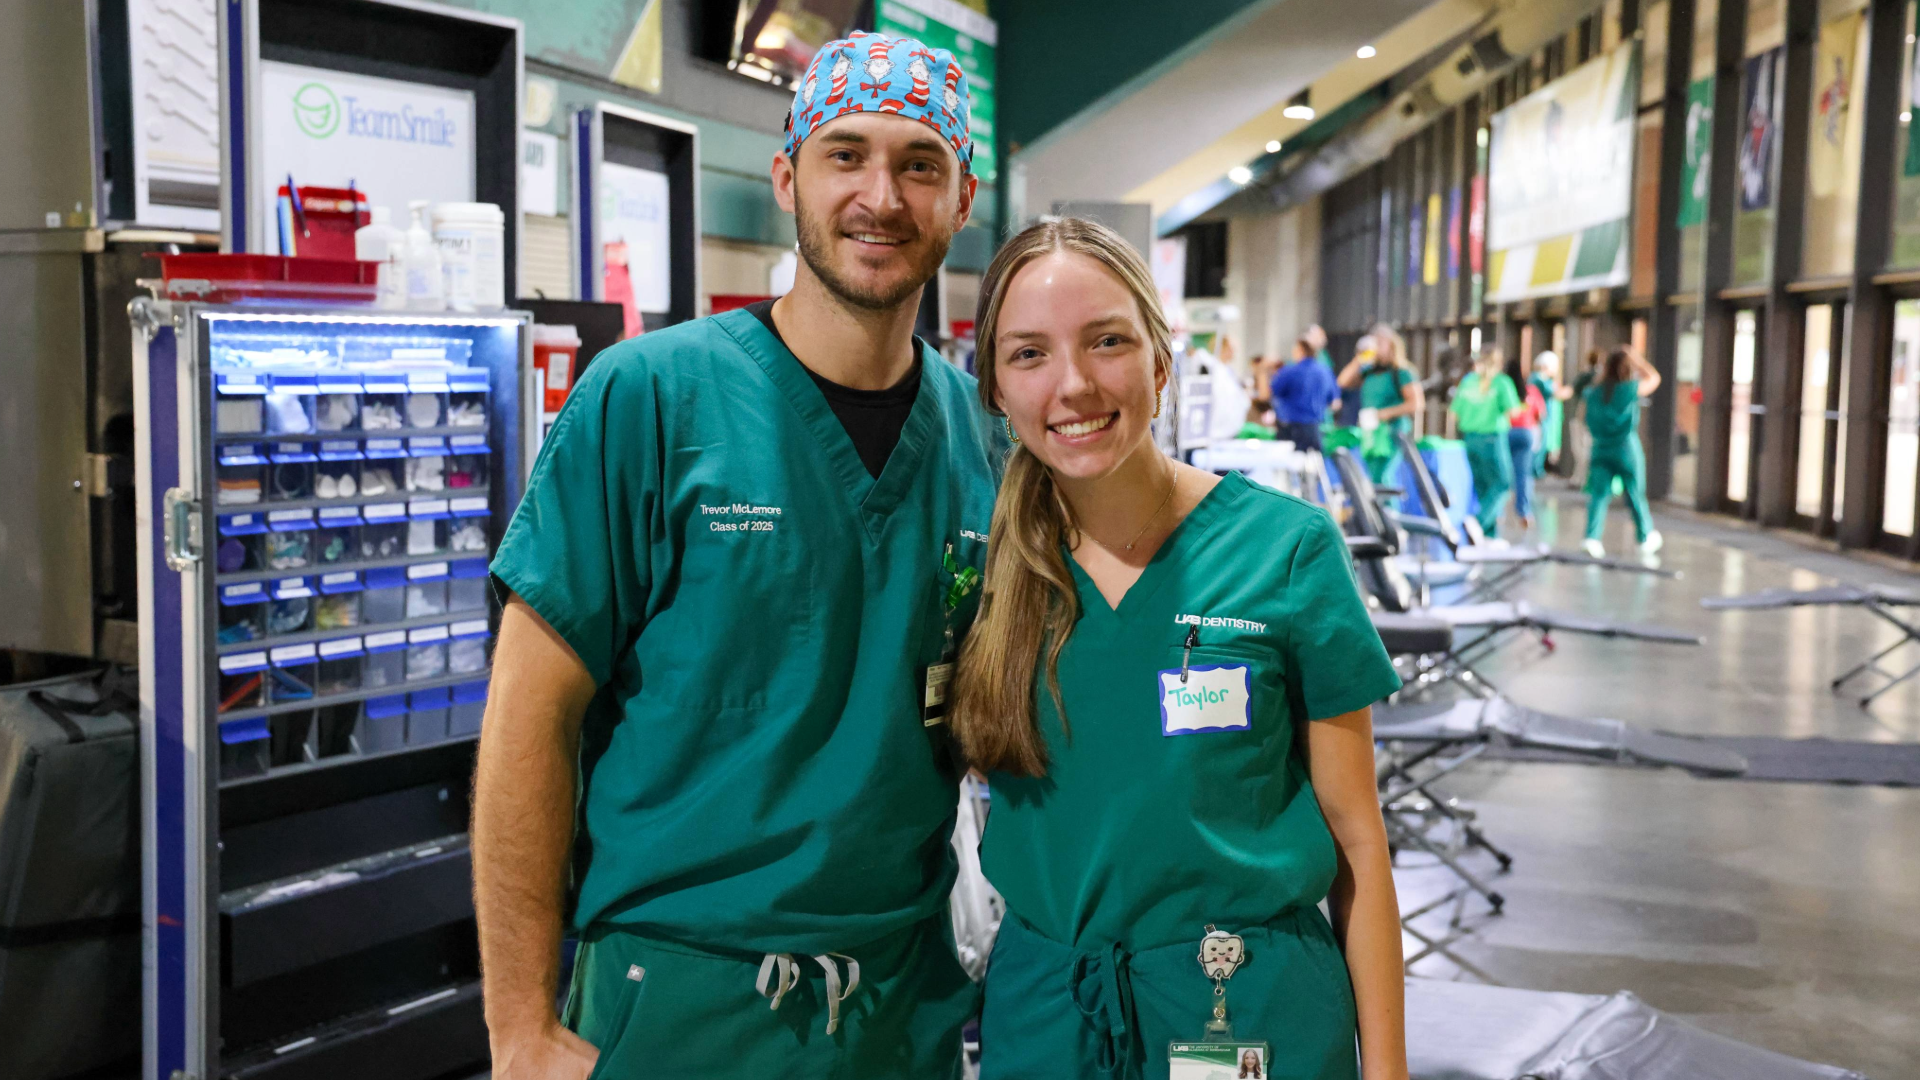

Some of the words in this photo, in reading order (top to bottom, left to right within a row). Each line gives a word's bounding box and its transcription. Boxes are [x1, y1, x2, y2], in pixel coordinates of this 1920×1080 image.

[342, 96, 456, 148] TeamSmile
[700, 504, 730, 515] Trevor
[732, 503, 782, 515] McLemore
[709, 521, 738, 532] Class
[739, 520, 750, 531] of
[750, 521, 774, 531] 2025
[1174, 613, 1202, 625] UAB
[1202, 616, 1267, 634] DENTISTRY
[1168, 685, 1229, 711] Taylor
